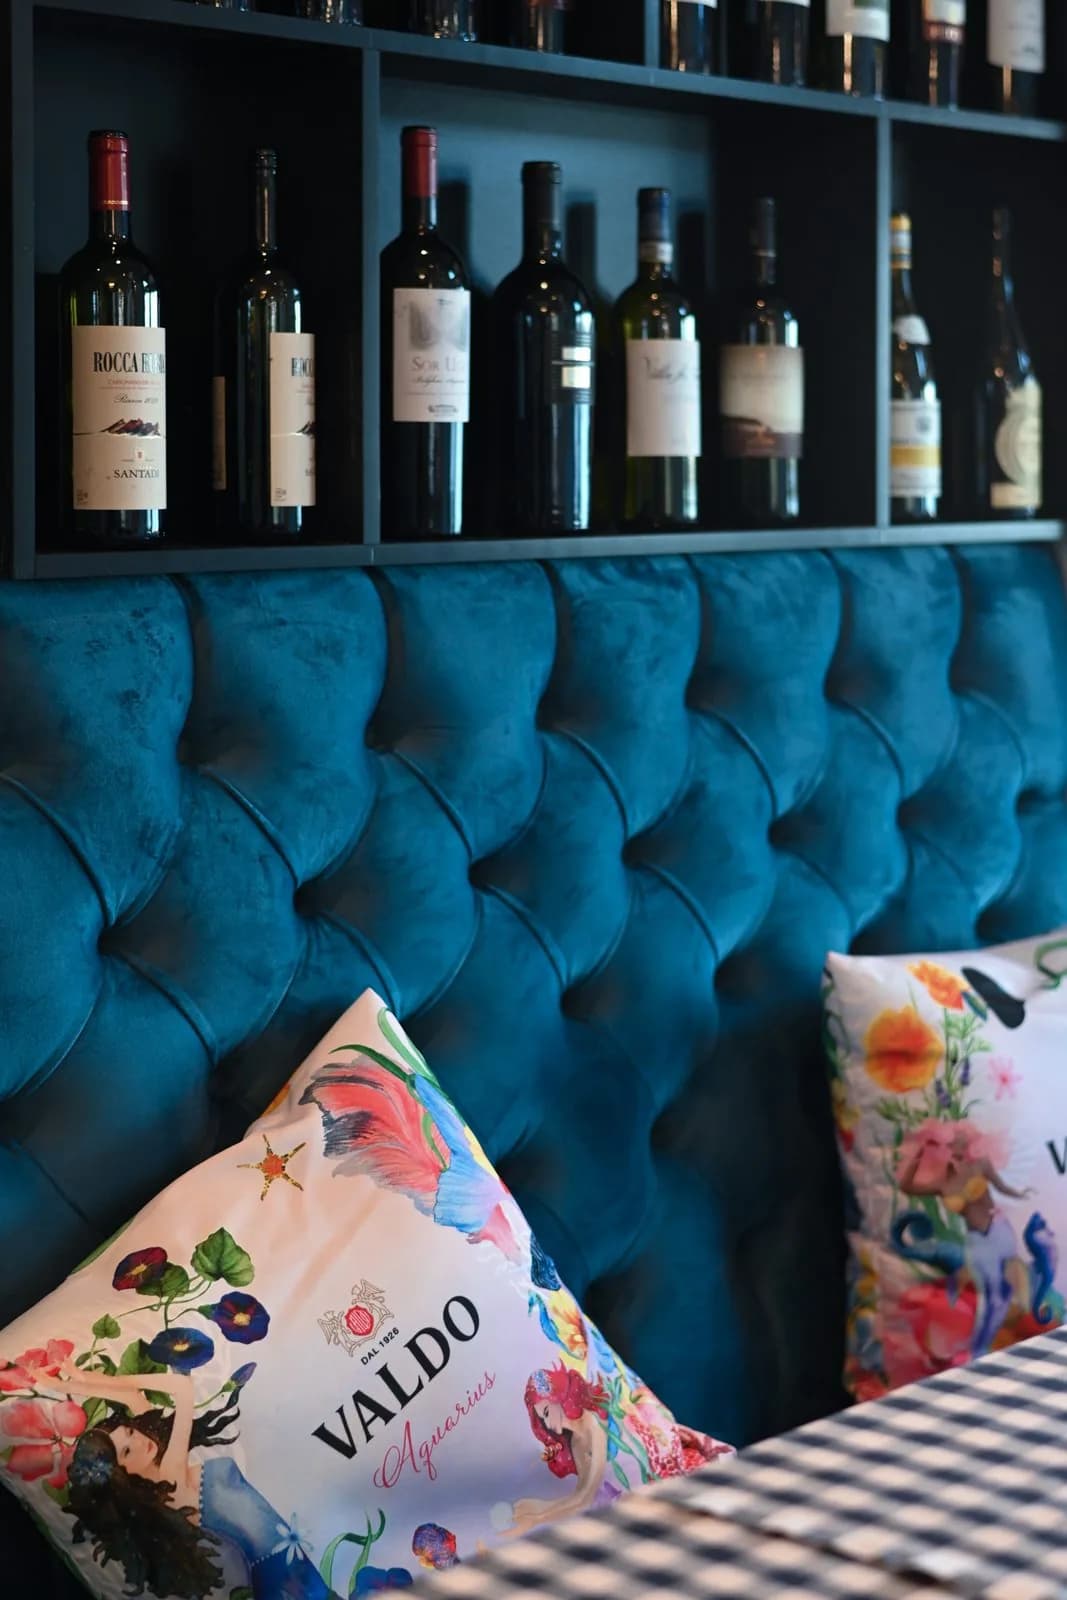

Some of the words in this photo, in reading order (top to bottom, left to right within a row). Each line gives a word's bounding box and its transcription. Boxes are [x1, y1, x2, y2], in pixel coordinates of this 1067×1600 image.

[93, 351, 138, 373] ROCCA
[311, 1295, 480, 1460] VALDO
[360, 1348, 380, 1365] DAL
[379, 1327, 400, 1348] 1926
[373, 1370, 496, 1488] Aquarius
